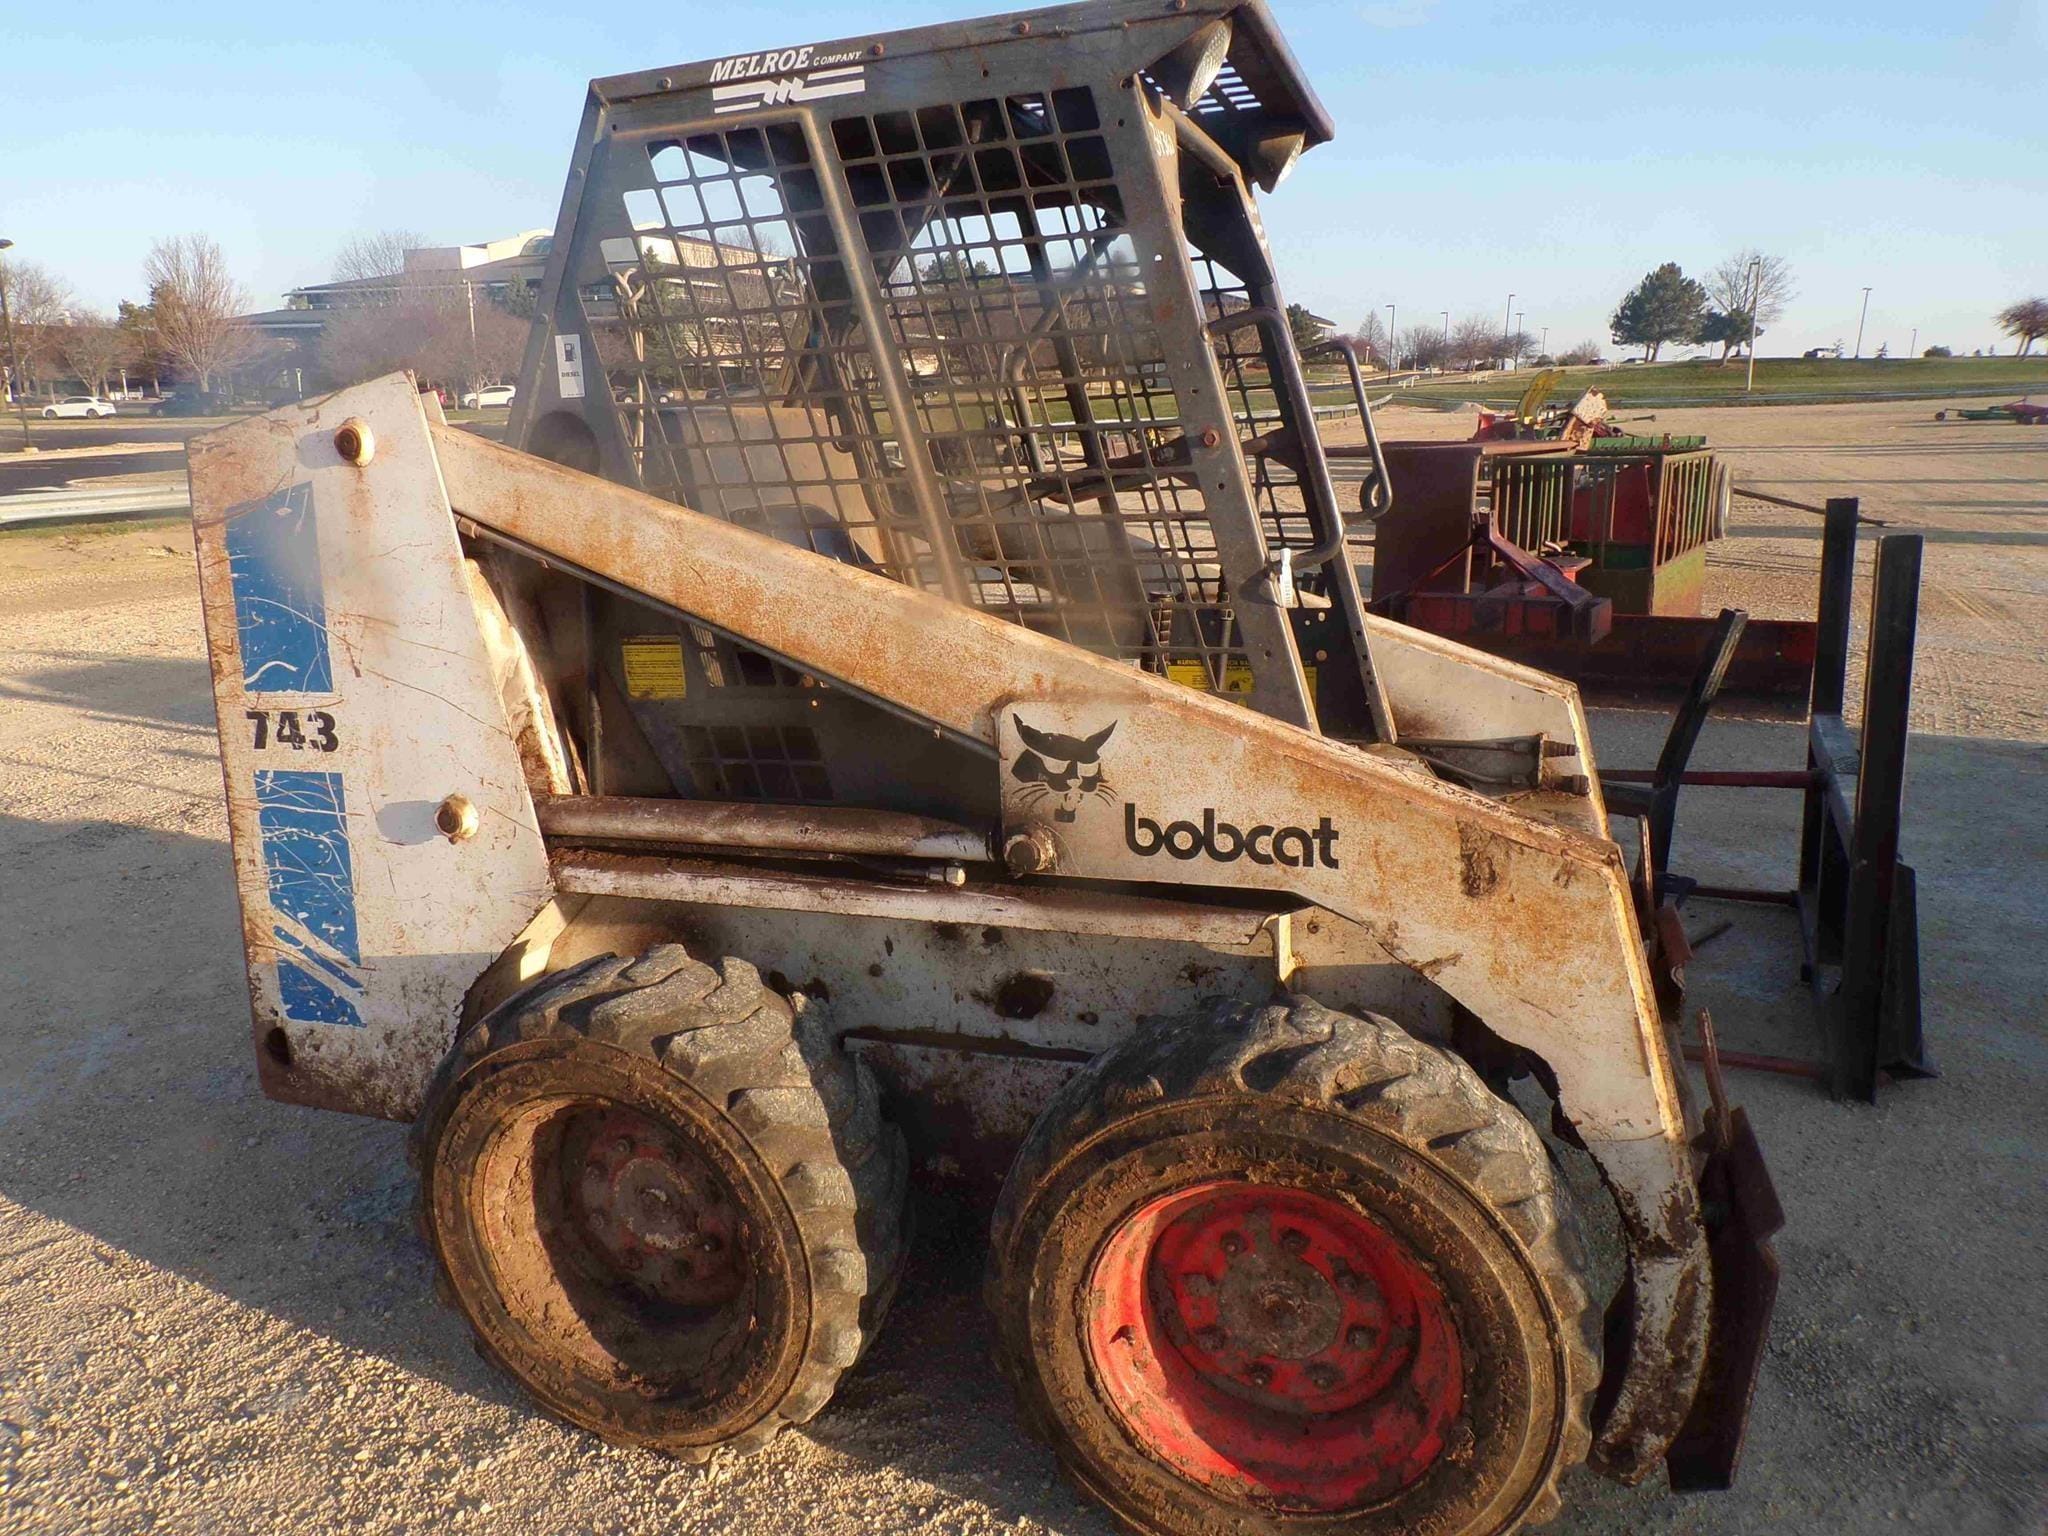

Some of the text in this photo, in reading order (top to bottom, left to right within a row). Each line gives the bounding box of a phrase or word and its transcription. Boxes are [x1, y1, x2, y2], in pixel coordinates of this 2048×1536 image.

[709, 46, 862, 83] MELROE COMPANY
[245, 711, 339, 752] 743
[1124, 802, 1339, 870] bobcat
